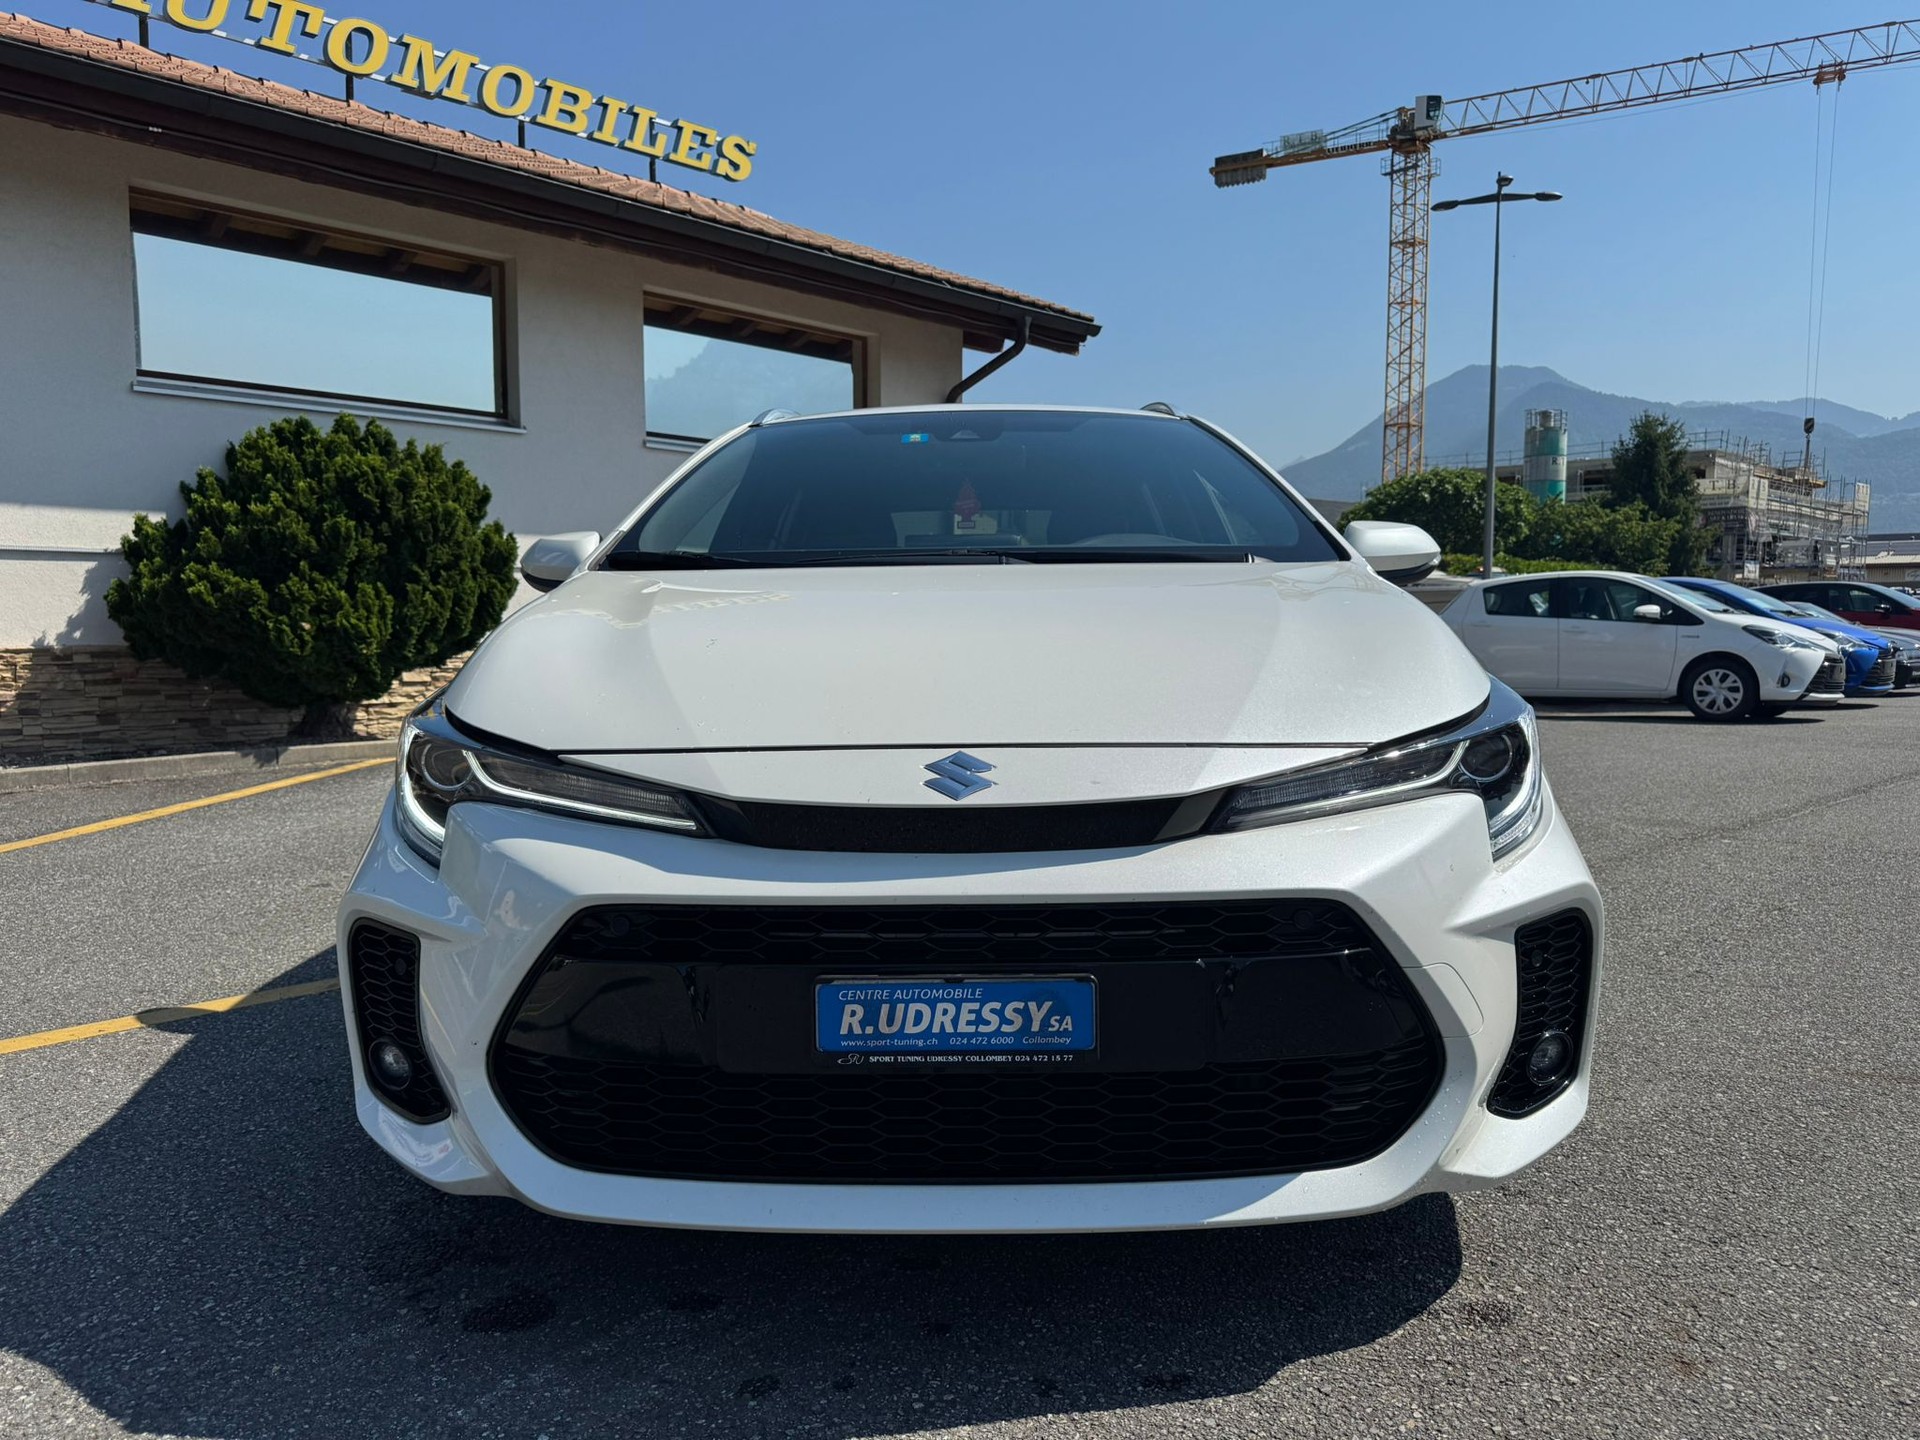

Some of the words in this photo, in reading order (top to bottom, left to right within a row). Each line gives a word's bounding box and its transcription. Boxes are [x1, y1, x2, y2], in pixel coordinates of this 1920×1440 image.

[86, 0, 757, 182] UTOMOBILES
[838, 989, 891, 1000] CENTRE
[893, 988, 983, 1000] AUTOMOBILE
[840, 1001, 1053, 1035] R.UDRESSY
[840, 1037, 938, 1047] www.sport-tuning.ch
[949, 1037, 968, 1045] 024
[970, 1036, 988, 1045] 472
[990, 1036, 1014, 1045] 6000
[1022, 1035, 1072, 1045] Collombey
